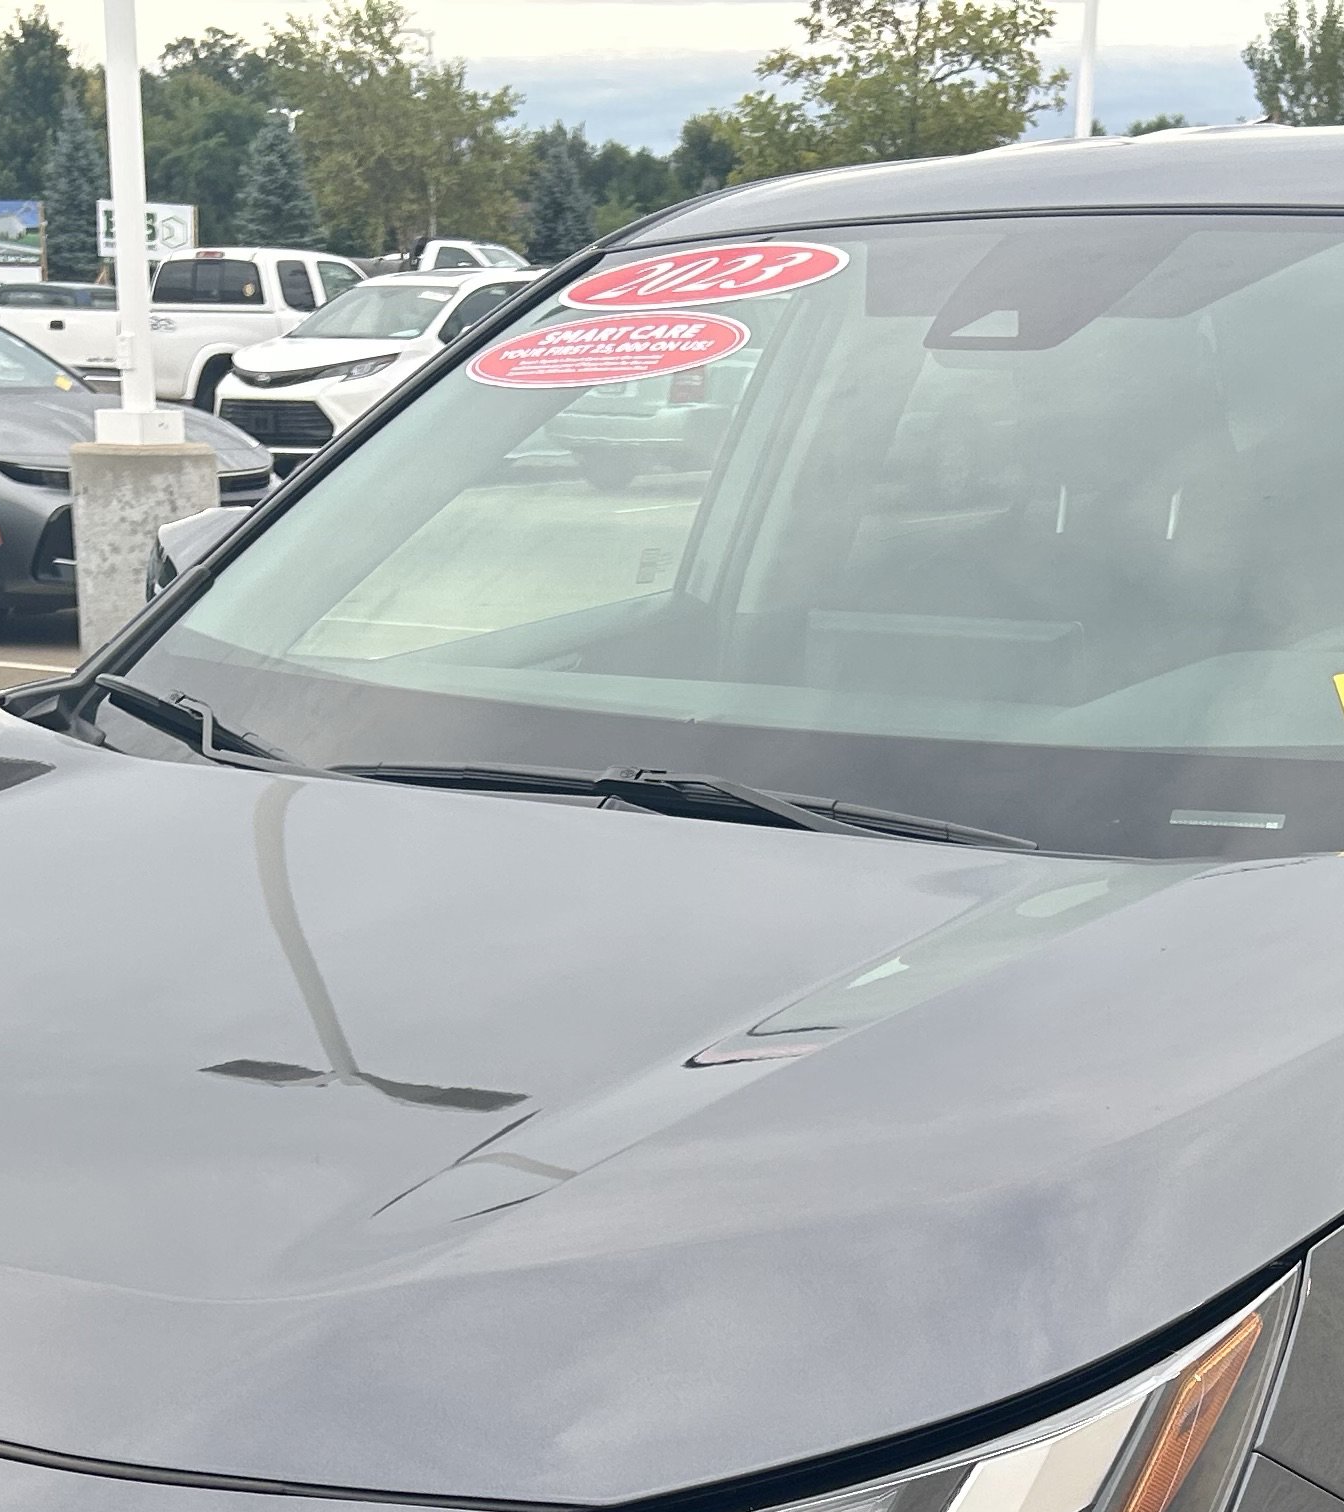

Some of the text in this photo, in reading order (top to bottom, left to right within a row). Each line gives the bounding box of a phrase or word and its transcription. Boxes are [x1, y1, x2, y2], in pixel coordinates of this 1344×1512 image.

[585, 252, 814, 301] 2023
[537, 323, 707, 346] SMART CARE
[499, 347, 547, 361] YOUR
[543, 344, 595, 357] FIRST
